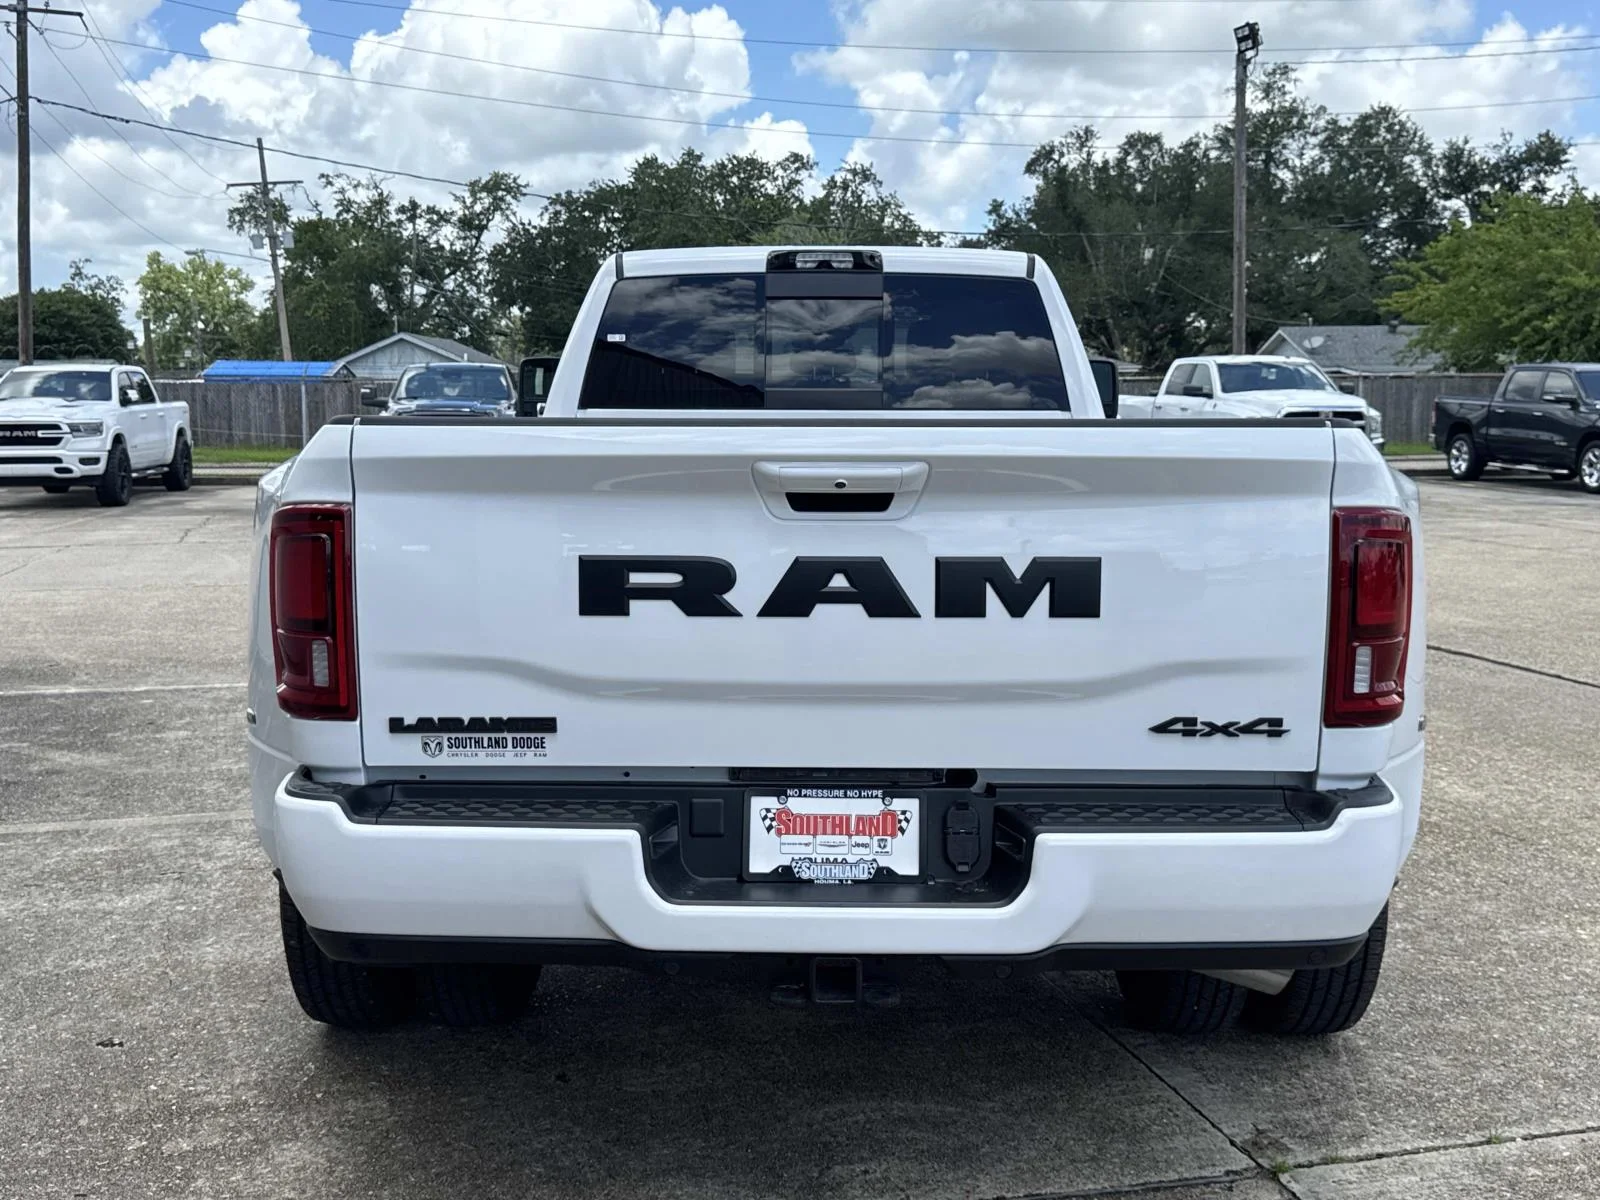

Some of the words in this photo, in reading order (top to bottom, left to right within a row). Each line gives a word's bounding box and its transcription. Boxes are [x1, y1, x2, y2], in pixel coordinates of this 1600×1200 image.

[579, 555, 1102, 618] RAM
[1148, 716, 1291, 738] 4x4
[446, 736, 508, 750] SOUTHLAND
[511, 736, 547, 750] DODGE
[787, 789, 800, 797] NO
[801, 789, 845, 798] PRESSURE
[847, 790, 860, 798] NO
[861, 790, 883, 798] HYPE
[775, 808, 898, 838] SOUTHLAND
[851, 841, 870, 850] Jeep
[801, 862, 869, 879] SOUTHLAND
